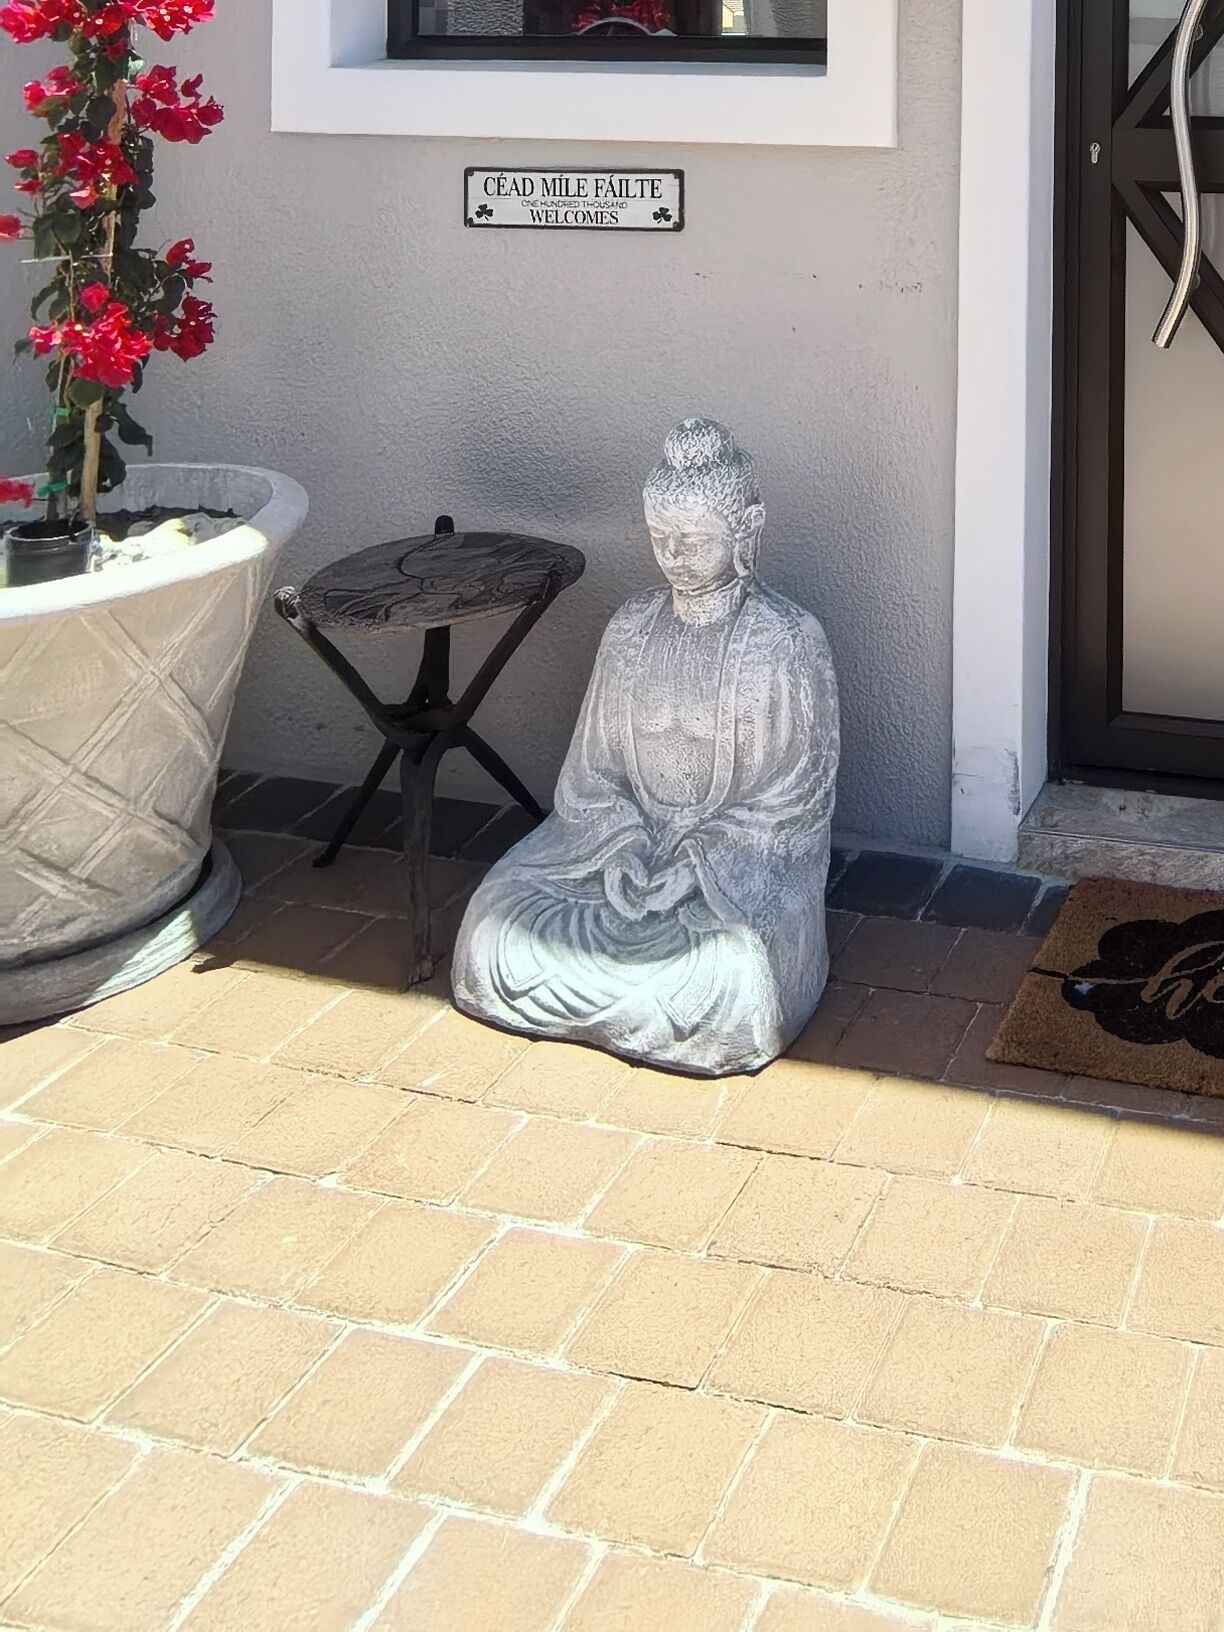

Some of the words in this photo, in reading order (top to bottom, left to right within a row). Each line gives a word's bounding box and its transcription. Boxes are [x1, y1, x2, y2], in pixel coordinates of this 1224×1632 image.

[483, 172, 534, 197] CÉAD
[540, 174, 589, 198] MÍLE
[594, 174, 662, 198] FÁILTE
[521, 199, 539, 208] ONE
[540, 199, 580, 209] HUNDRED
[582, 200, 628, 210] THOUSAND
[529, 208, 619, 225] WELCOMES
